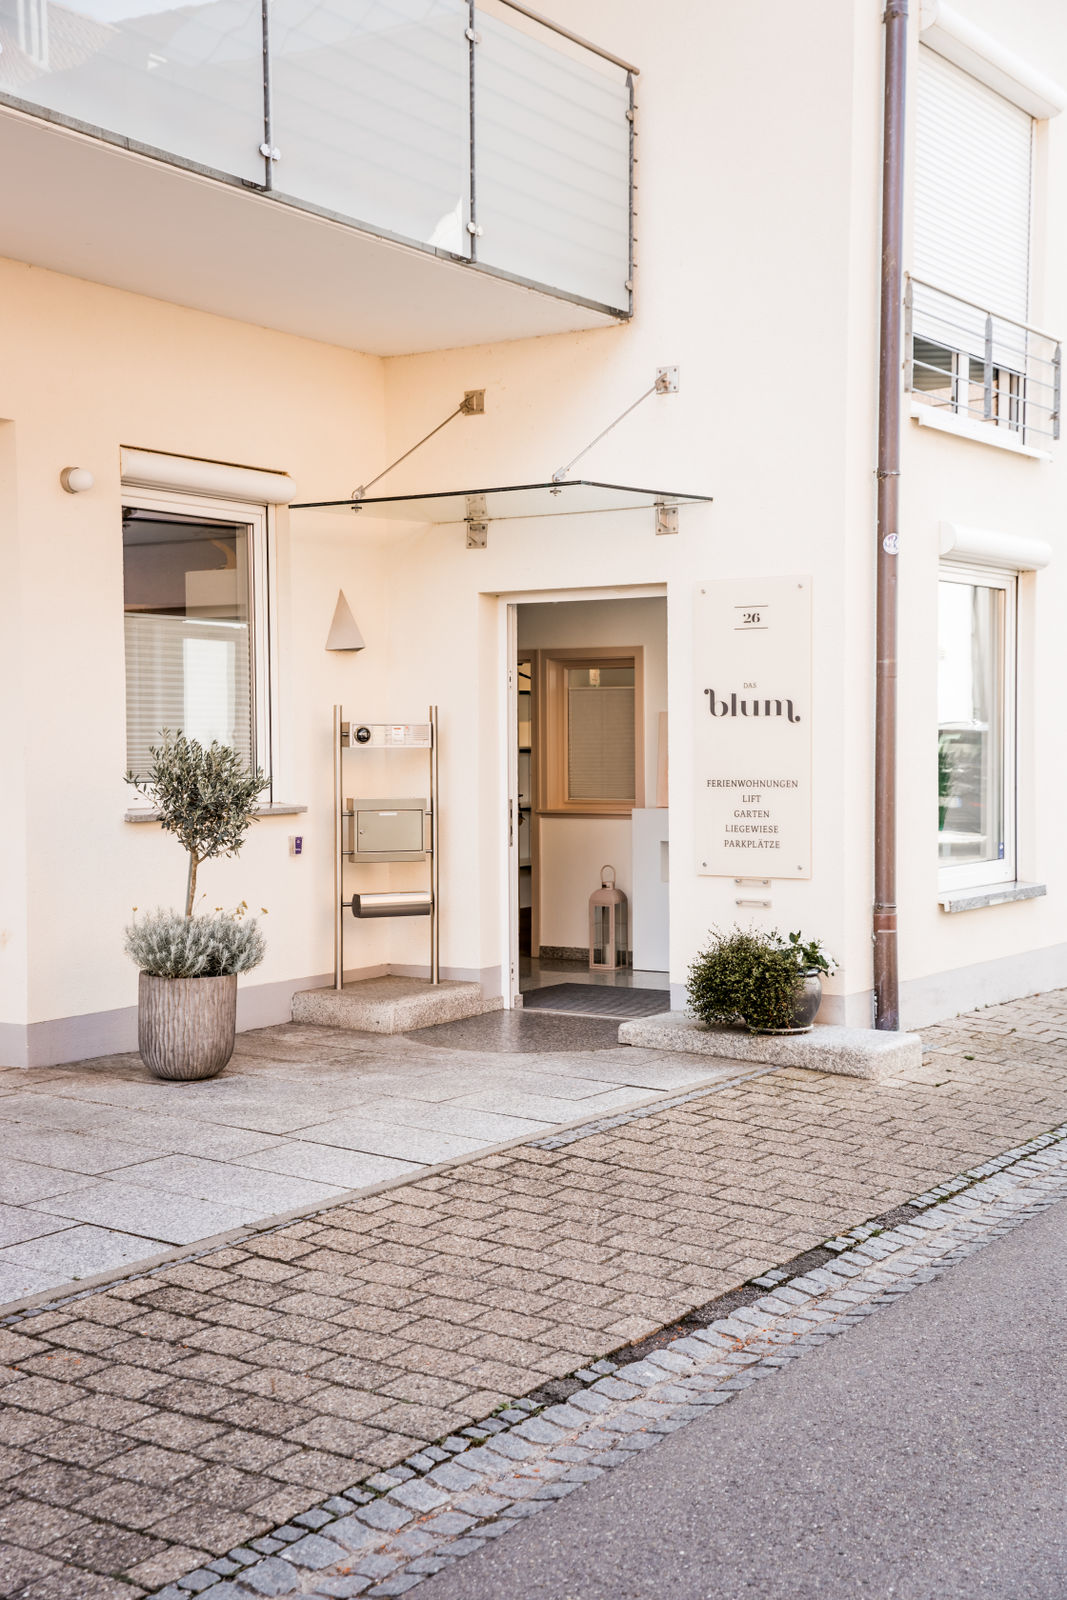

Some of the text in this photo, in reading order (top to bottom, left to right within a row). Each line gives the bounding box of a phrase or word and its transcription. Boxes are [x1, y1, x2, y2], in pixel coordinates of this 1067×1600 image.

[743, 612, 761, 624] 26
[706, 779, 799, 788] FERIENWOHNUNGEN
[742, 794, 762, 803] LIFT
[733, 809, 770, 818] GARTEN
[725, 824, 779, 834] LIEGEWIESE
[724, 838, 781, 849] PARKPLÄTZE
